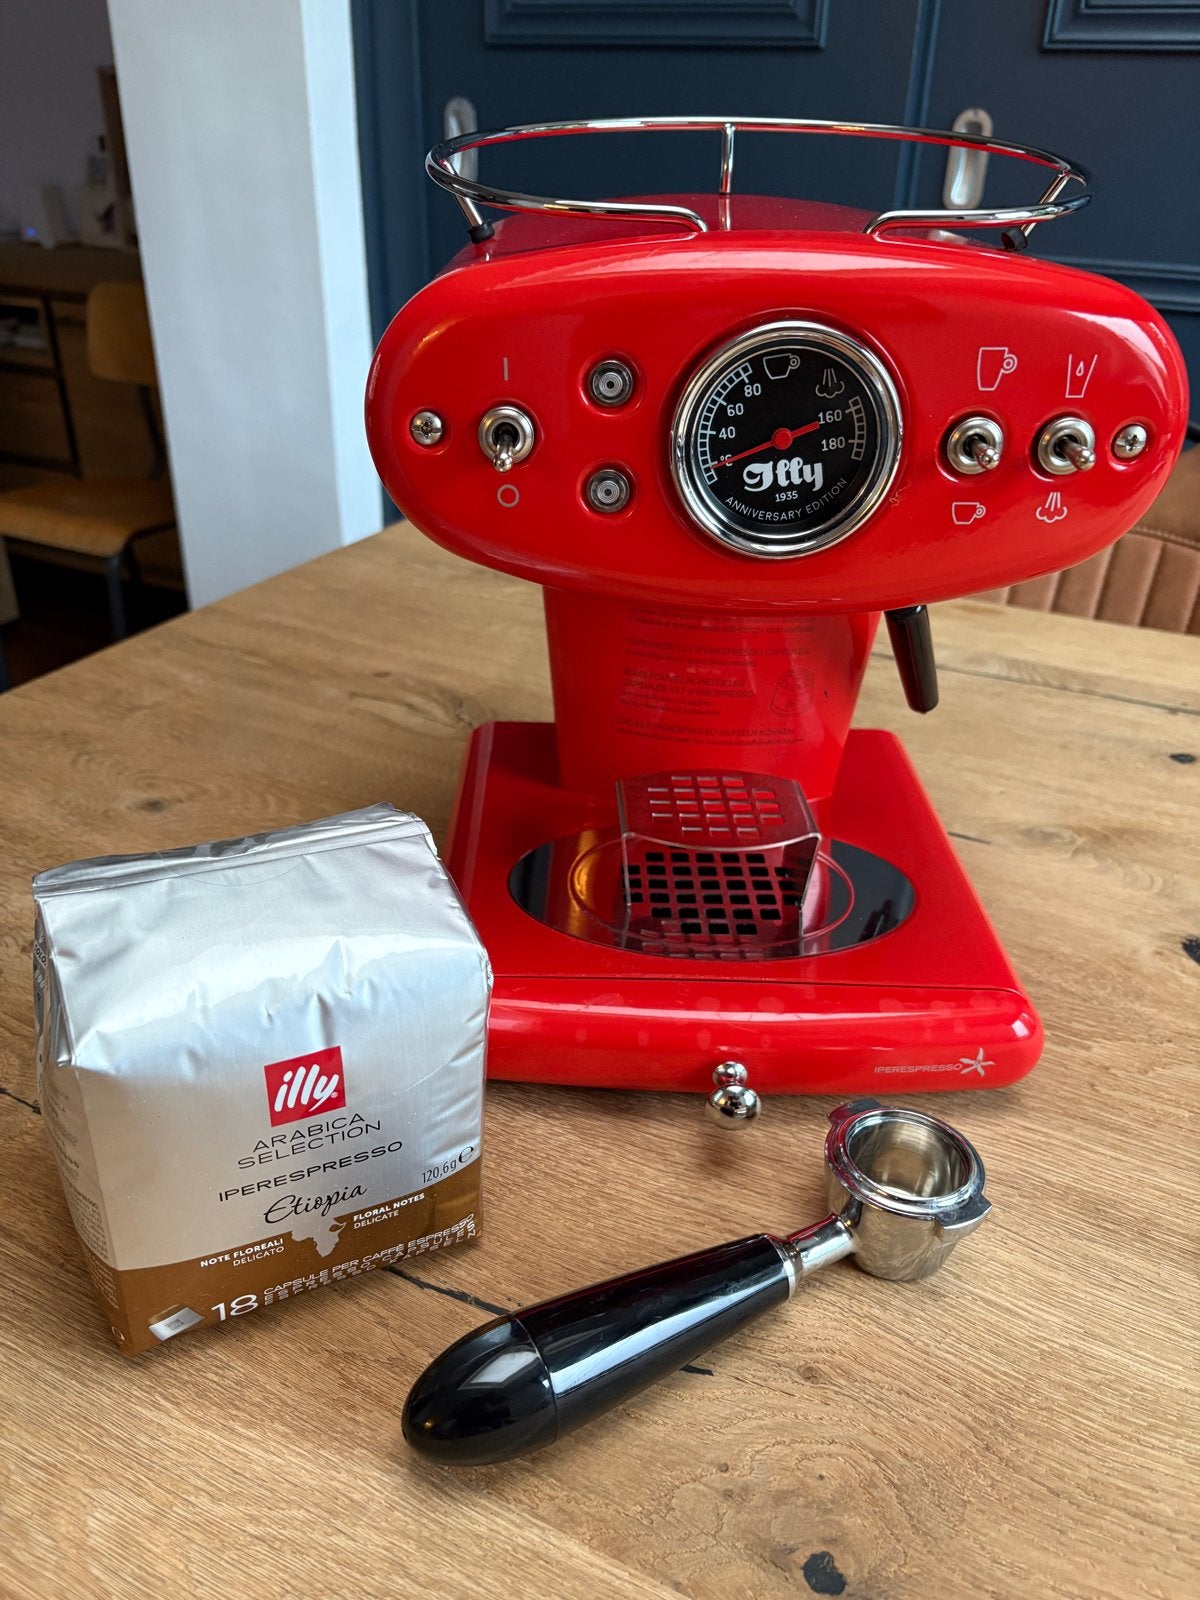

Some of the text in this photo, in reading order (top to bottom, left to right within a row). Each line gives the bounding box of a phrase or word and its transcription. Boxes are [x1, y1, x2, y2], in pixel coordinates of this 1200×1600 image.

[744, 383, 762, 397] 80
[727, 403, 744, 417] 60
[818, 409, 842, 425] 160
[719, 427, 736, 440] 40
[821, 438, 846, 452] 180
[725, 479, 847, 521] ANNIVERSARY EDITION
[775, 491, 799, 503] 1935
[874, 1063, 962, 1074] IPERESPRESSO
[274, 1064, 339, 1112] illy
[238, 1120, 381, 1169] SELECTION
[253, 1113, 366, 1153] ARABICA
[218, 1141, 403, 1202] IPERESPRESSO
[264, 1183, 368, 1224] Etiopia
[353, 1192, 426, 1222] FLORAL NOTES
[353, 1209, 400, 1230] DELICATE
[200, 1238, 284, 1268] NOTE FLOREALI
[264, 1268, 329, 1295] CAPSULE
[332, 1259, 360, 1273] PER
[407, 1213, 475, 1248] ESPRESSO
[382, 1220, 476, 1261] CAPSULES
[233, 1246, 285, 1267] DELICATO
[211, 1294, 259, 1321] 18
